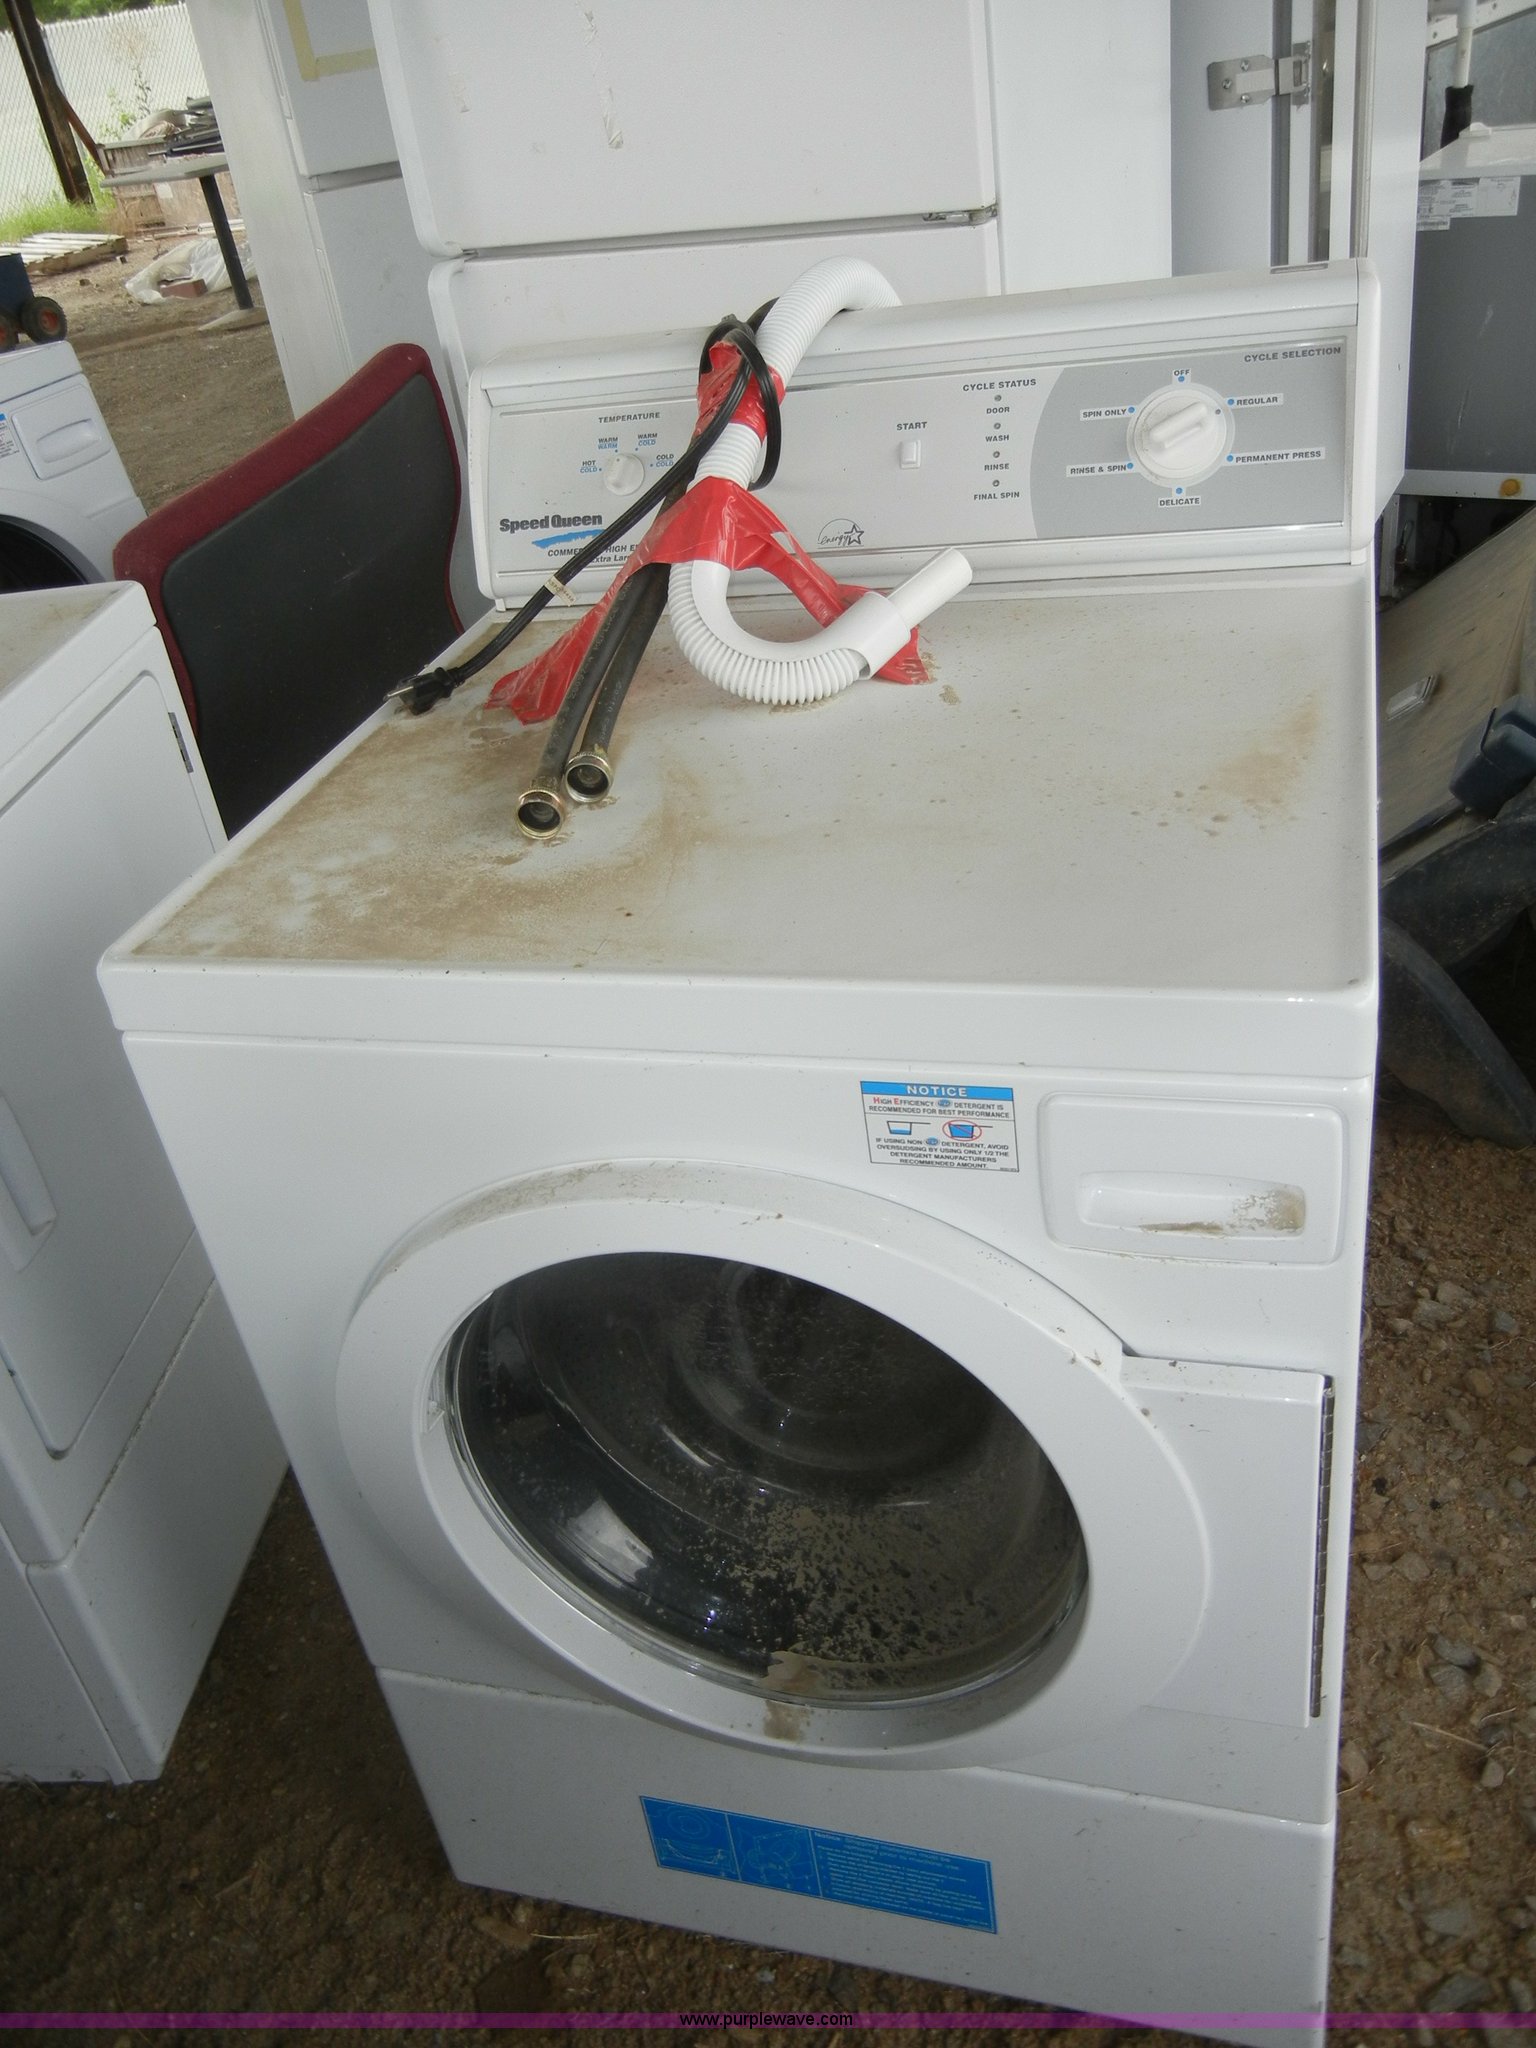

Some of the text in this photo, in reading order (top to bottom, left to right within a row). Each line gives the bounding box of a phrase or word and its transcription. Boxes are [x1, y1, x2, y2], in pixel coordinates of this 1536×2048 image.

[1244, 346, 1341, 363] CYCLE SELECTION
[963, 379, 1037, 392] CYCLE STATUS
[1236, 396, 1278, 406] REGULAR
[986, 406, 1010, 414] DOOR
[1083, 408, 1127, 418] SPIN ONLY
[598, 412, 661, 424] TEMPERATURE
[896, 421, 927, 431] START
[638, 439, 656, 447] COLD
[985, 434, 1010, 442] WASH
[656, 453, 675, 461] COLD
[1235, 450, 1321, 463] PERMANENT PRESS
[656, 460, 674, 468] COLD
[984, 463, 1010, 471] RINSE
[1070, 466, 1095, 475] RINSE
[1107, 464, 1127, 472] SPIN
[974, 491, 1020, 501] FINAL SPIN
[1159, 497, 1200, 506] DELICATE
[499, 514, 603, 534] Speed Queen
[907, 1085, 968, 1097] NOTICE
[954, 1102, 995, 1110] DETERGENT
[869, 1106, 921, 1114] RECOMMENDED
[957, 1110, 1009, 1118] PERFORMANCE
[877, 1144, 927, 1152] OVERSUDSING
[900, 1159, 955, 1167] RECOMMENDED
[934, 1154, 997, 1163] MANUFACTURERS
